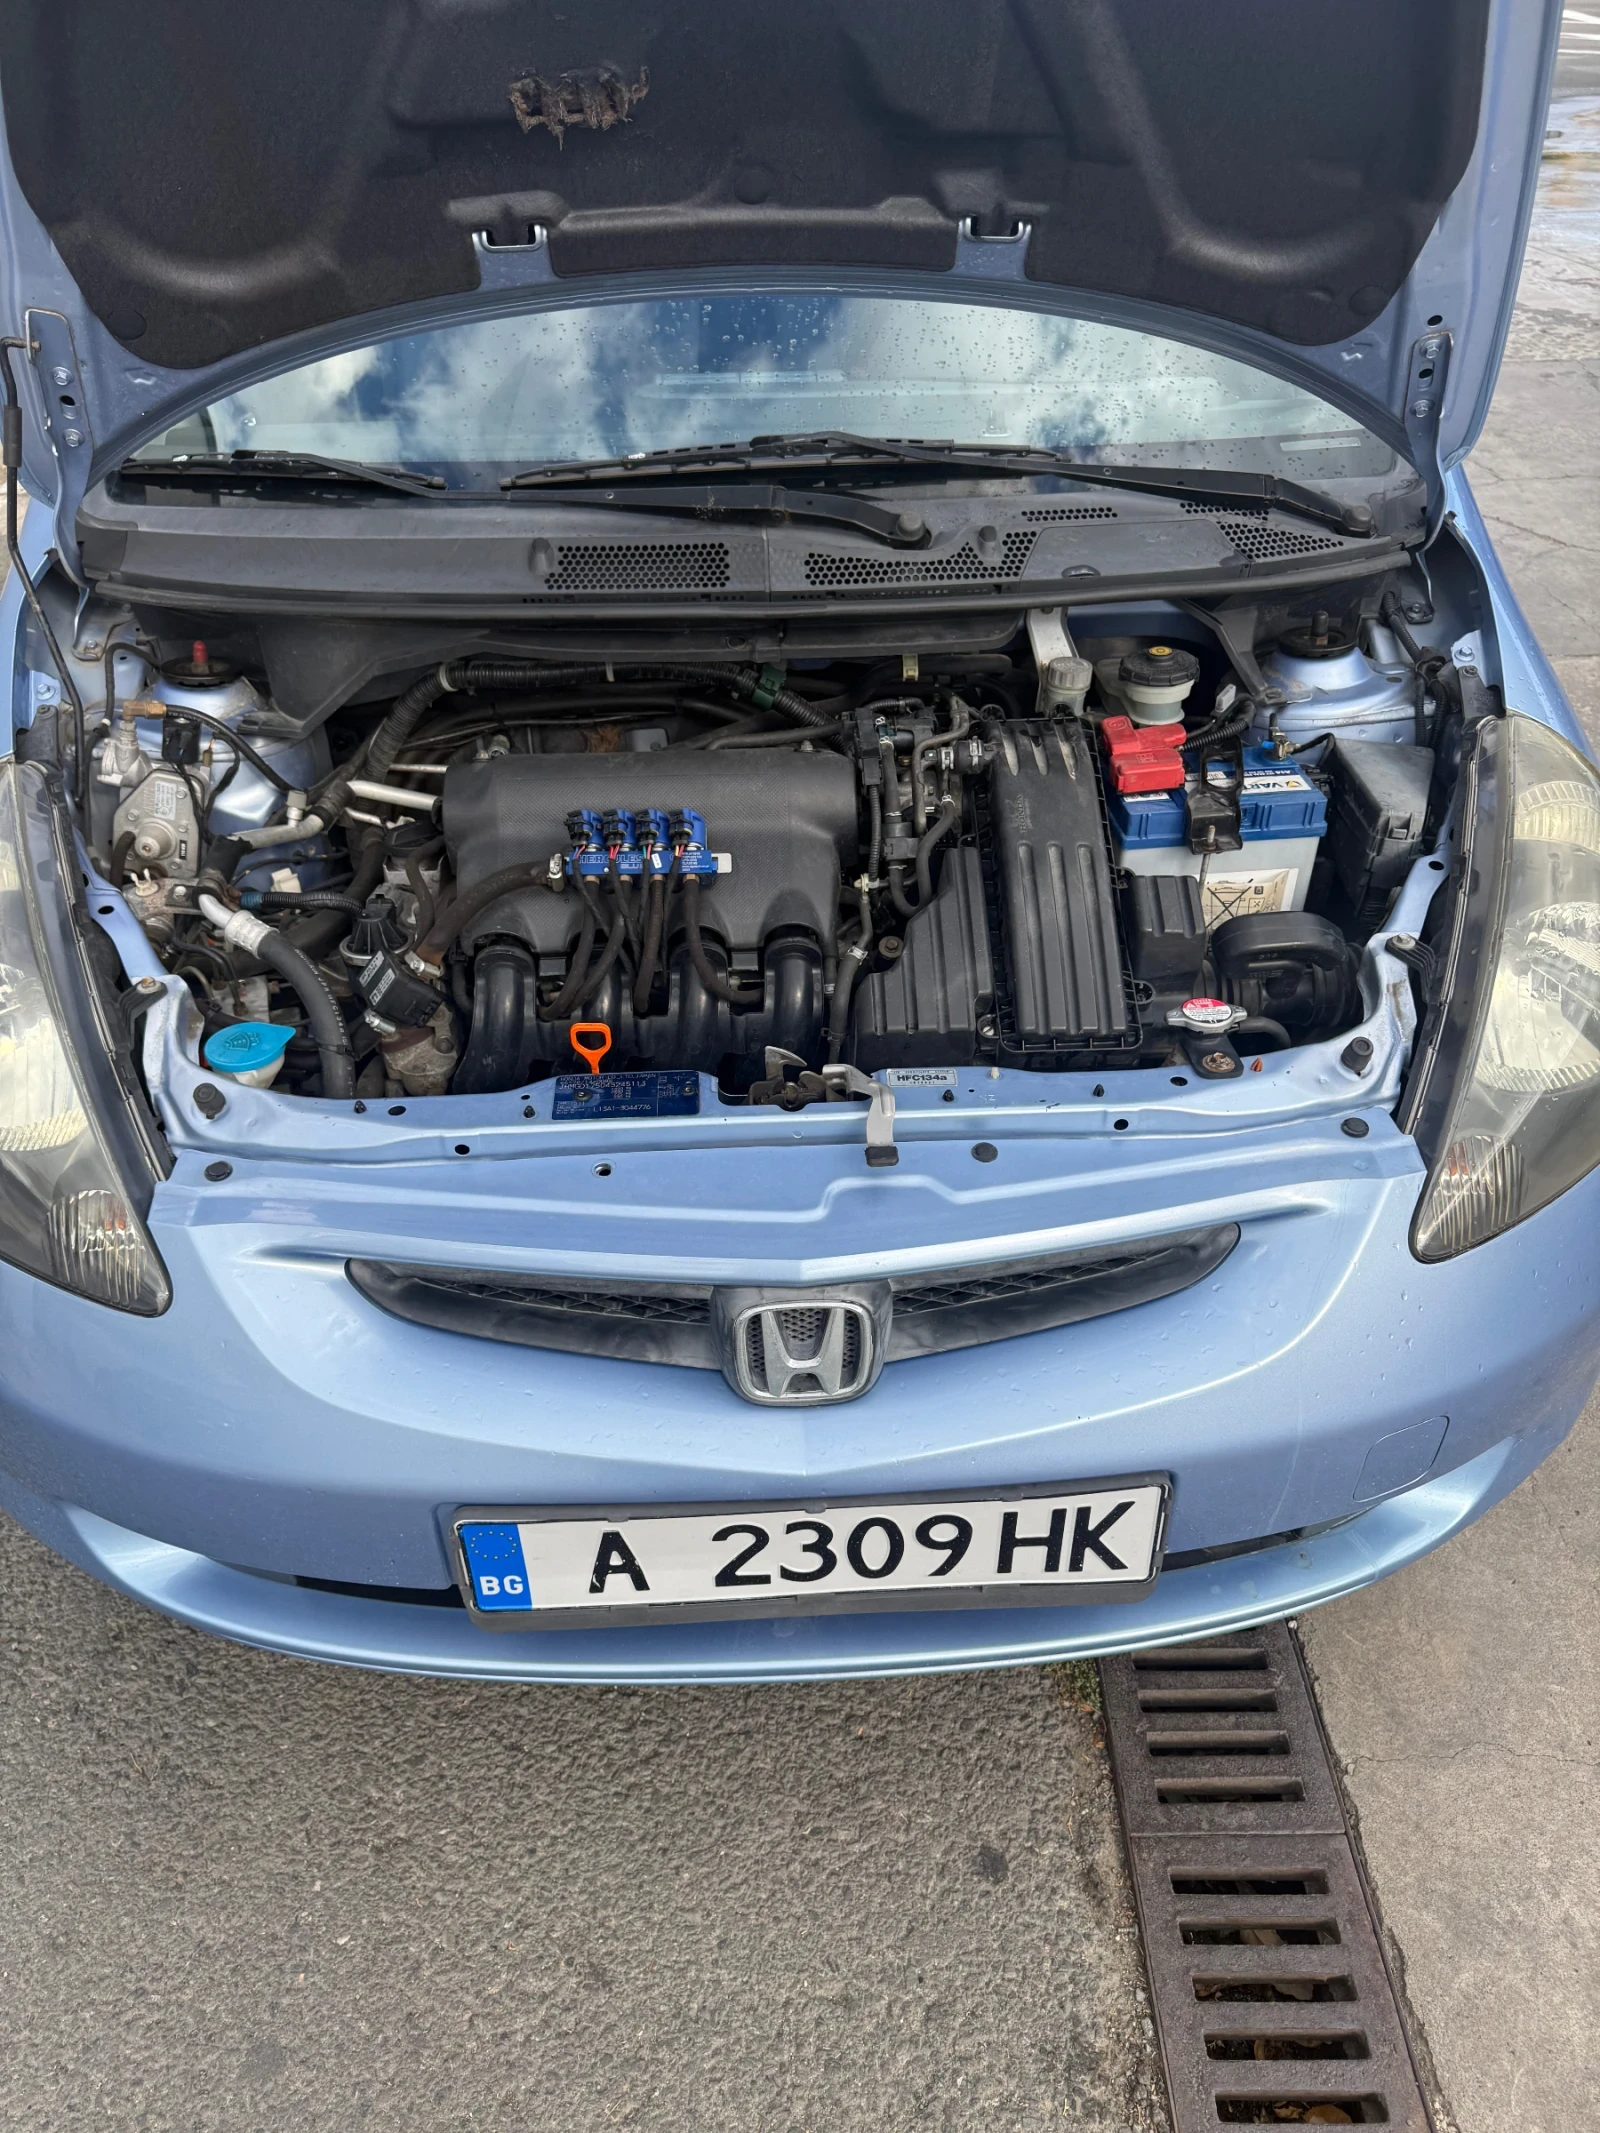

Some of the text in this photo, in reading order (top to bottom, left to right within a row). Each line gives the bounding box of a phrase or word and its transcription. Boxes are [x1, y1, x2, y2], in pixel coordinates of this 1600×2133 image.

[1242, 782, 1284, 791] VART
[589, 1501, 1137, 1594] A 2309 HK
[482, 1576, 524, 1597] BG
